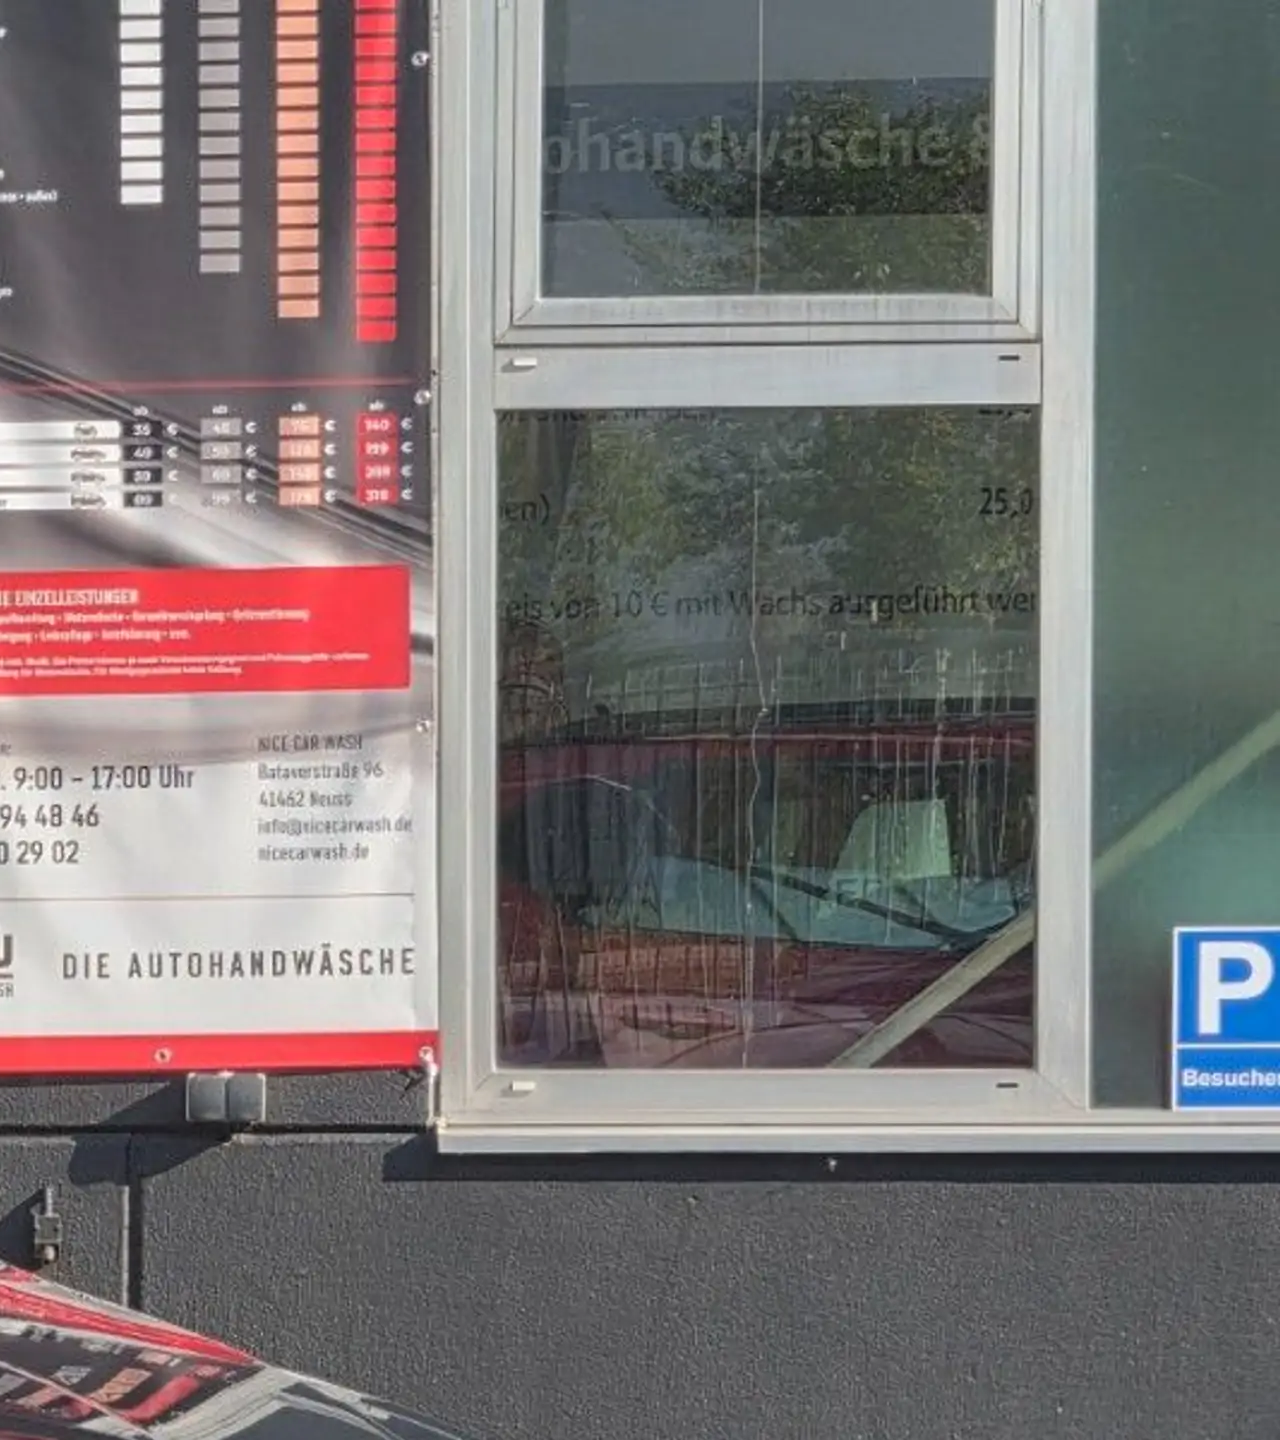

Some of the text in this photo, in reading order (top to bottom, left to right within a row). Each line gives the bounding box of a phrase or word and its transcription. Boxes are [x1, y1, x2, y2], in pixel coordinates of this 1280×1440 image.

[14, 766, 63, 791] 9:00
[91, 765, 152, 790] 17:00
[158, 764, 194, 789] Uhr
[34, 804, 64, 829] 48
[71, 803, 101, 828] 46
[16, 841, 45, 865] 29
[51, 840, 80, 865] 02
[62, 941, 417, 980] DIE AUTOHANDWÄSCHE
[1198, 941, 1274, 1035] P
